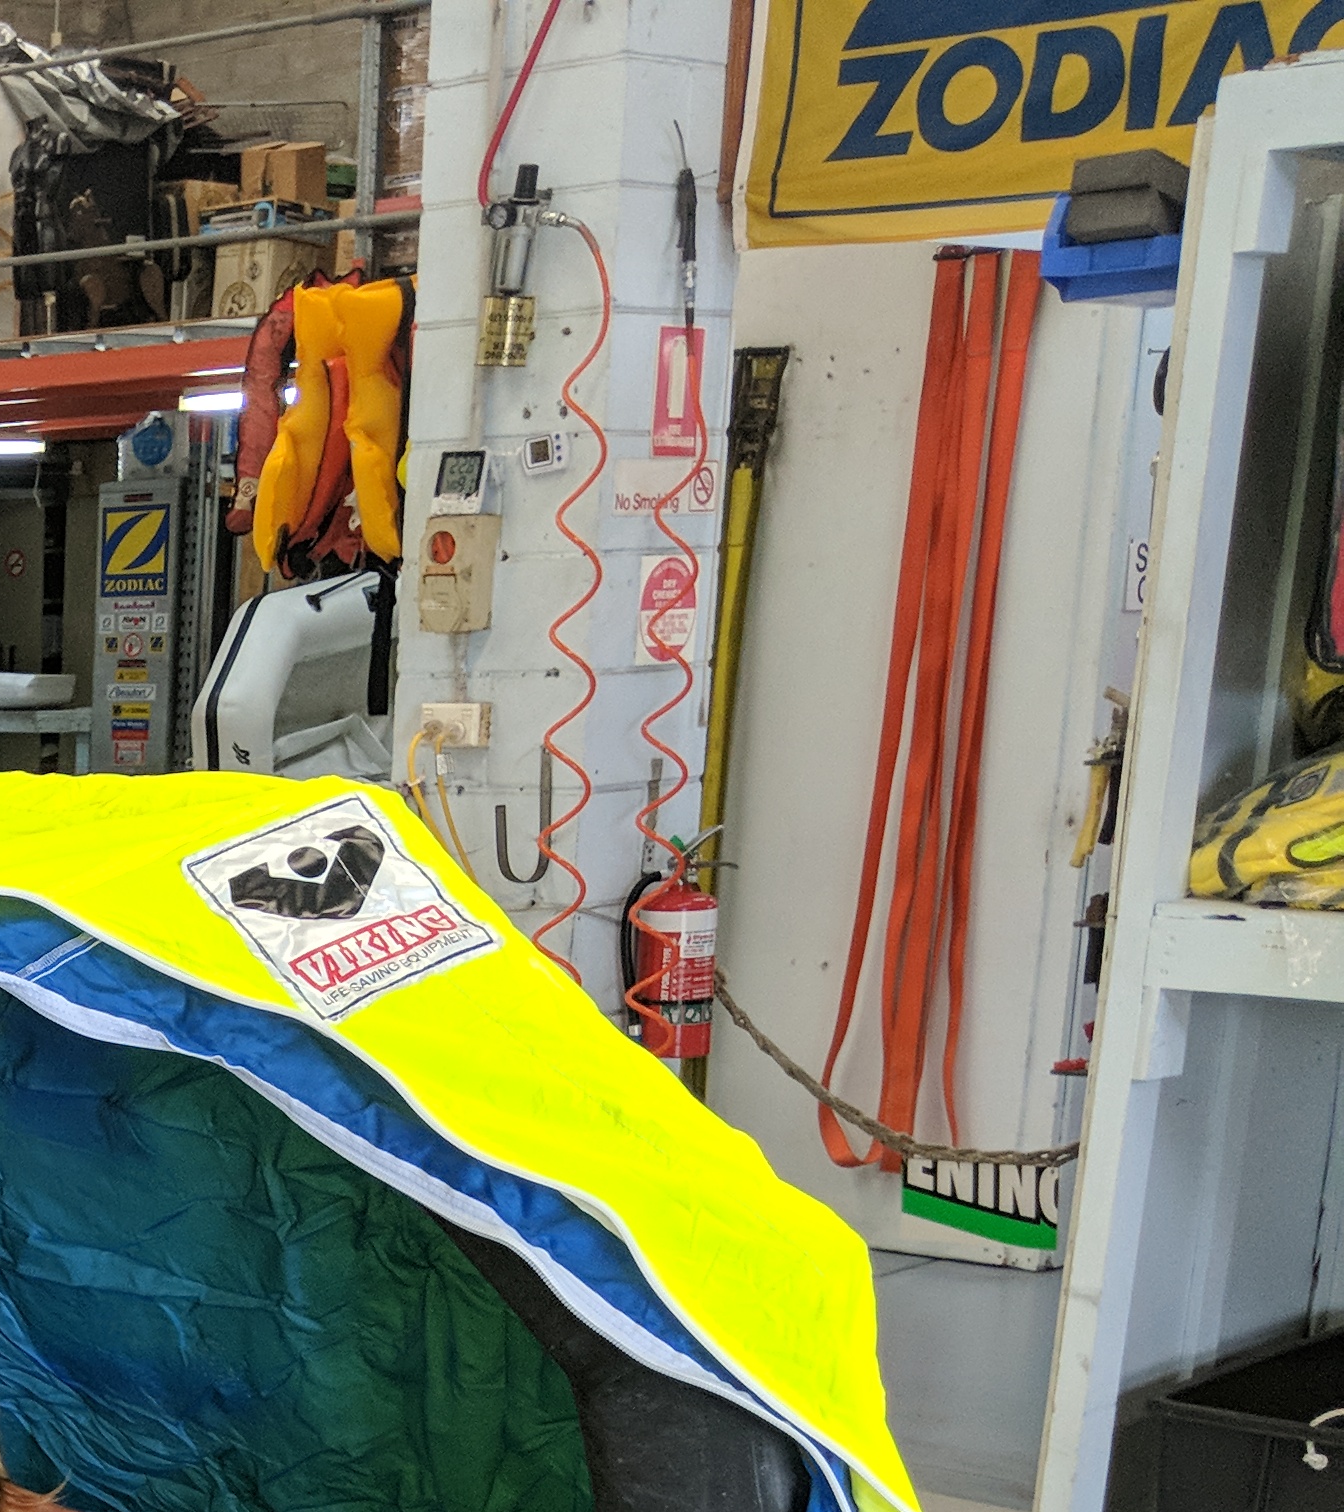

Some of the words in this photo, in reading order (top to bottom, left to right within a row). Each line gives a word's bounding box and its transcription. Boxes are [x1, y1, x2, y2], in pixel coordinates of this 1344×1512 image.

[615, 493, 631, 511] No
[104, 577, 164, 593] ZODIAC
[289, 905, 458, 992] VIKING
[398, 928, 473, 968] EQUIPMENT
